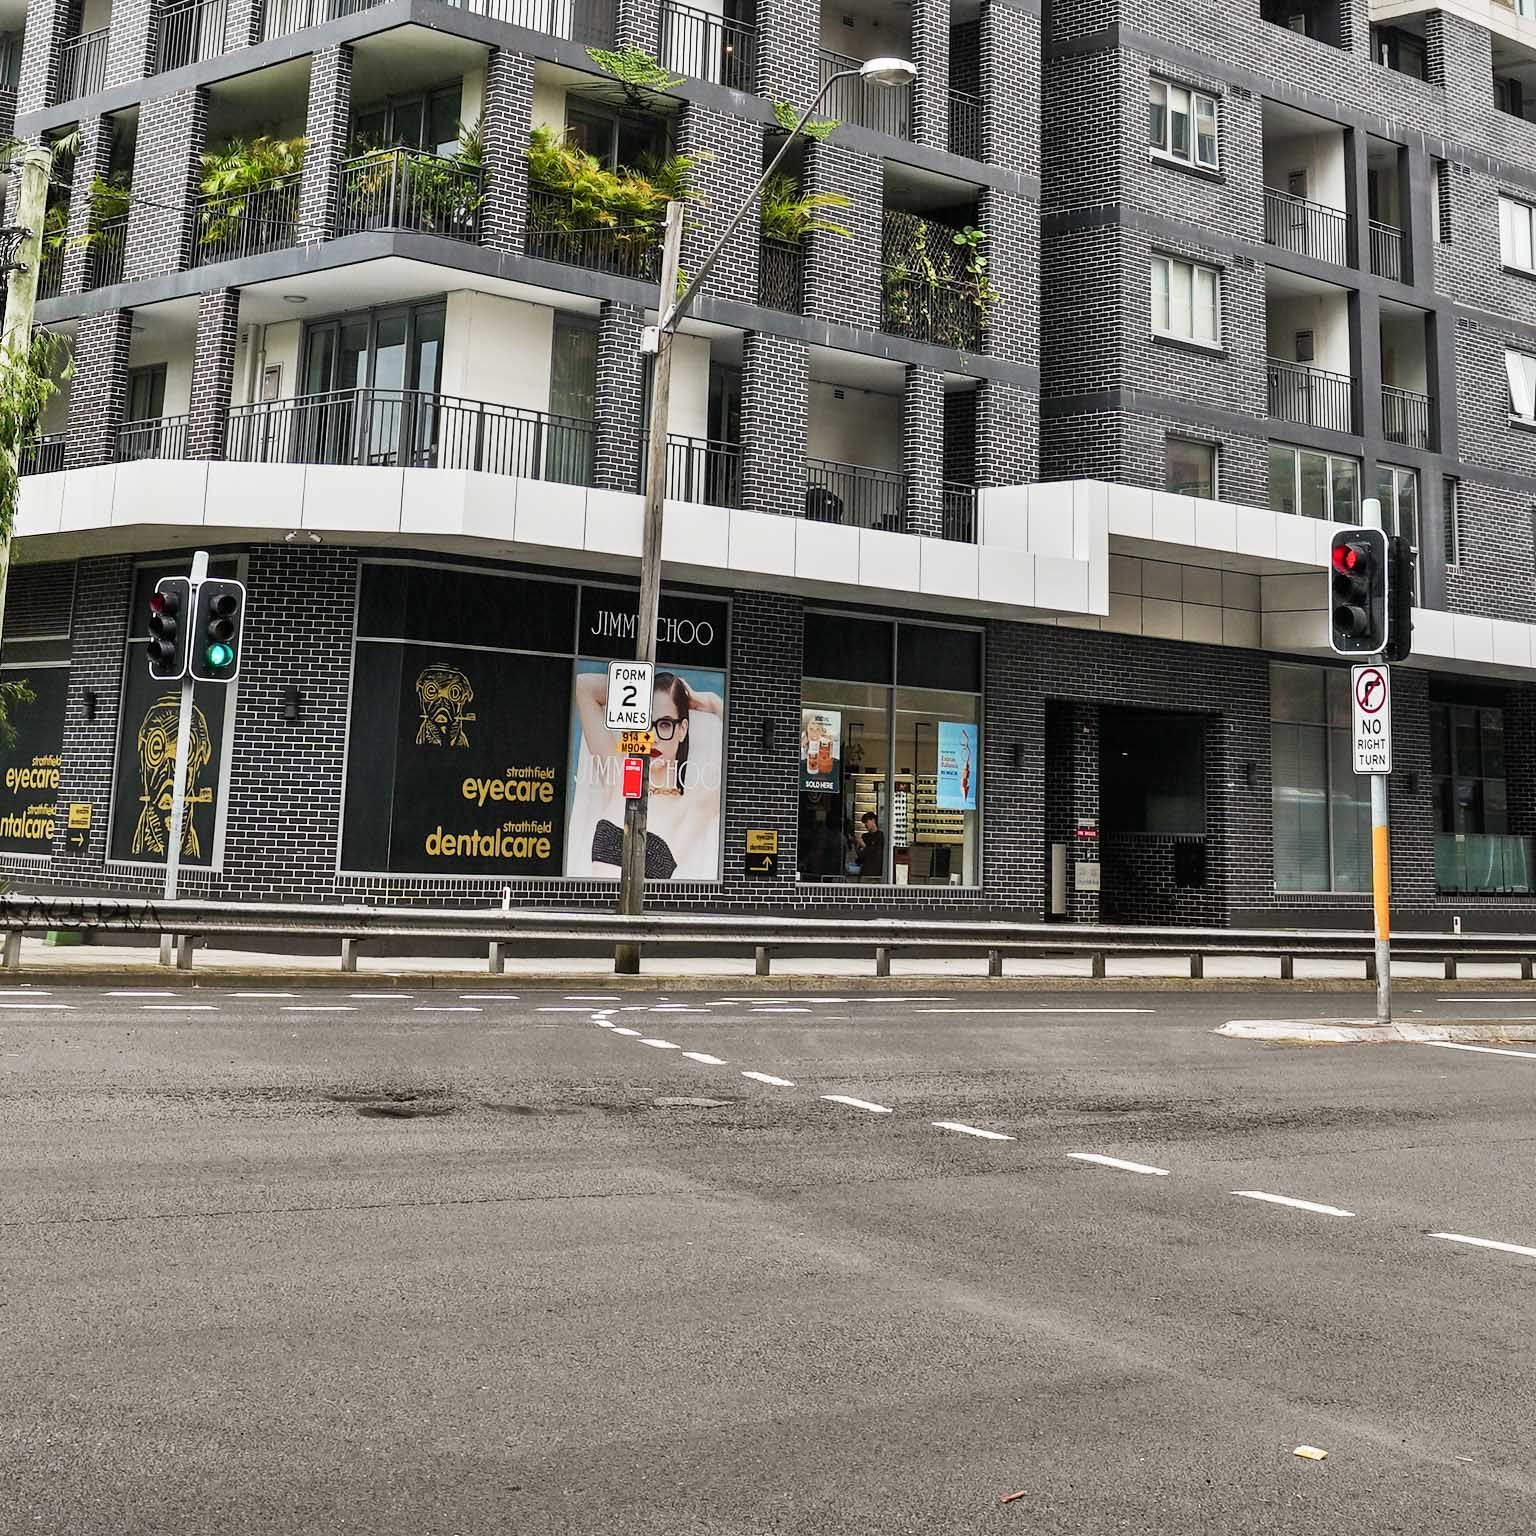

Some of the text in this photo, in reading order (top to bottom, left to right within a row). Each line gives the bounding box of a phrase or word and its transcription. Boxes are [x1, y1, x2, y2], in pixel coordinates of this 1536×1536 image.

[591, 611, 714, 645] JIMM CHOO
[616, 669, 646, 680] FORM
[622, 686, 637, 706] 2
[609, 712, 647, 724] LANES
[1363, 719, 1381, 734] NO
[622, 733, 638, 742] 914
[1358, 739, 1386, 750] RIGHT
[1360, 754, 1386, 765] TURN
[507, 766, 554, 779] strathfield
[6, 768, 60, 794] eyecare
[462, 777, 553, 807] eyecare
[503, 820, 552, 833] strathfield
[425, 826, 551, 859] dentalcare
